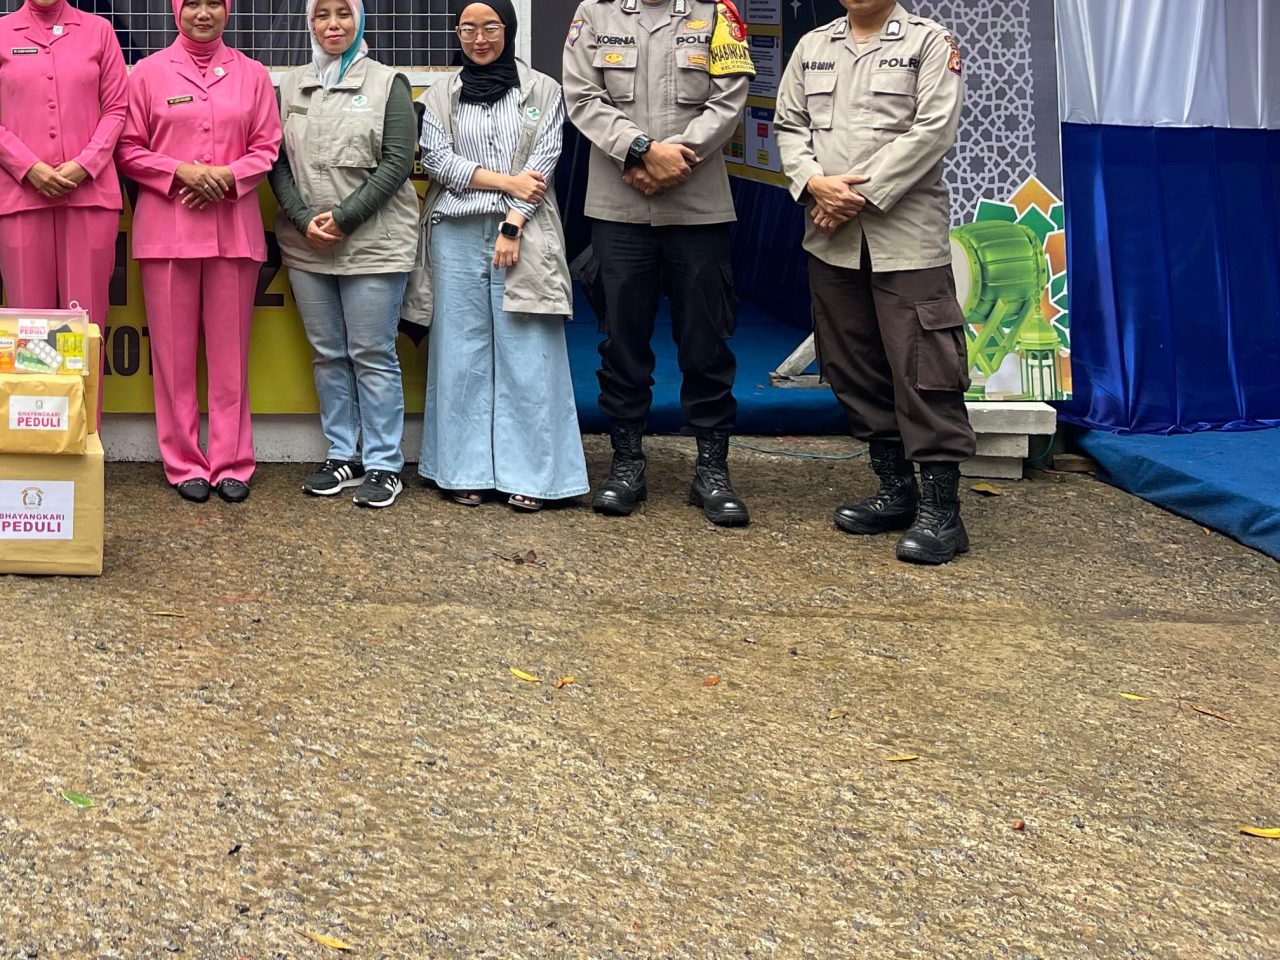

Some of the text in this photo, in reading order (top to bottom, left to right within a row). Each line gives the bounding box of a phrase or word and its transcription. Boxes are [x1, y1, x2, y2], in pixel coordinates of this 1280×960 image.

[676, 34, 712, 45] POLR
[19, 327, 46, 335] PEDULI
[17, 416, 61, 428] PEDULI
[1, 521, 61, 533] PEDULI
